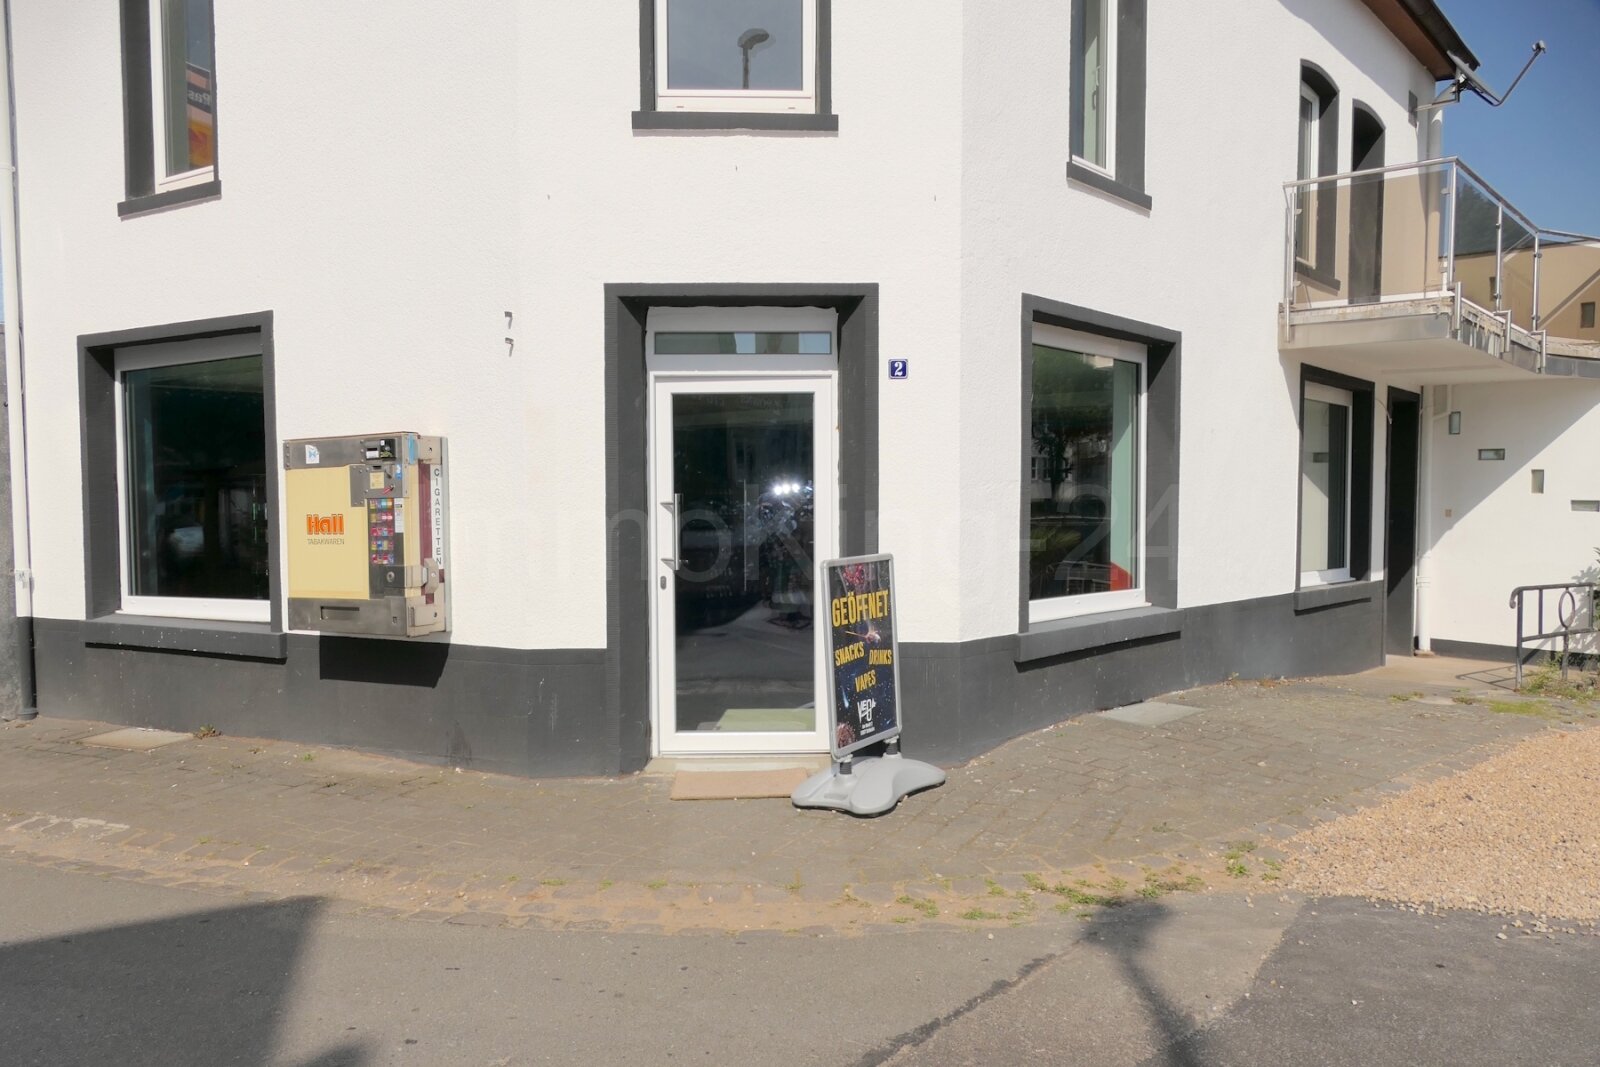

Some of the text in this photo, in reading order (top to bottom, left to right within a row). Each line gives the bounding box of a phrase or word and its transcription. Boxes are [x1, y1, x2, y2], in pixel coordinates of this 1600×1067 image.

[895, 362, 903, 376] 2
[306, 513, 345, 535] Hall
[434, 468, 442, 565] CIGARETTEN
[832, 589, 889, 627] GEÖFFNET
[835, 641, 864, 666] SNACKS
[869, 649, 892, 664] DRINKS
[855, 669, 876, 692] VAPES
